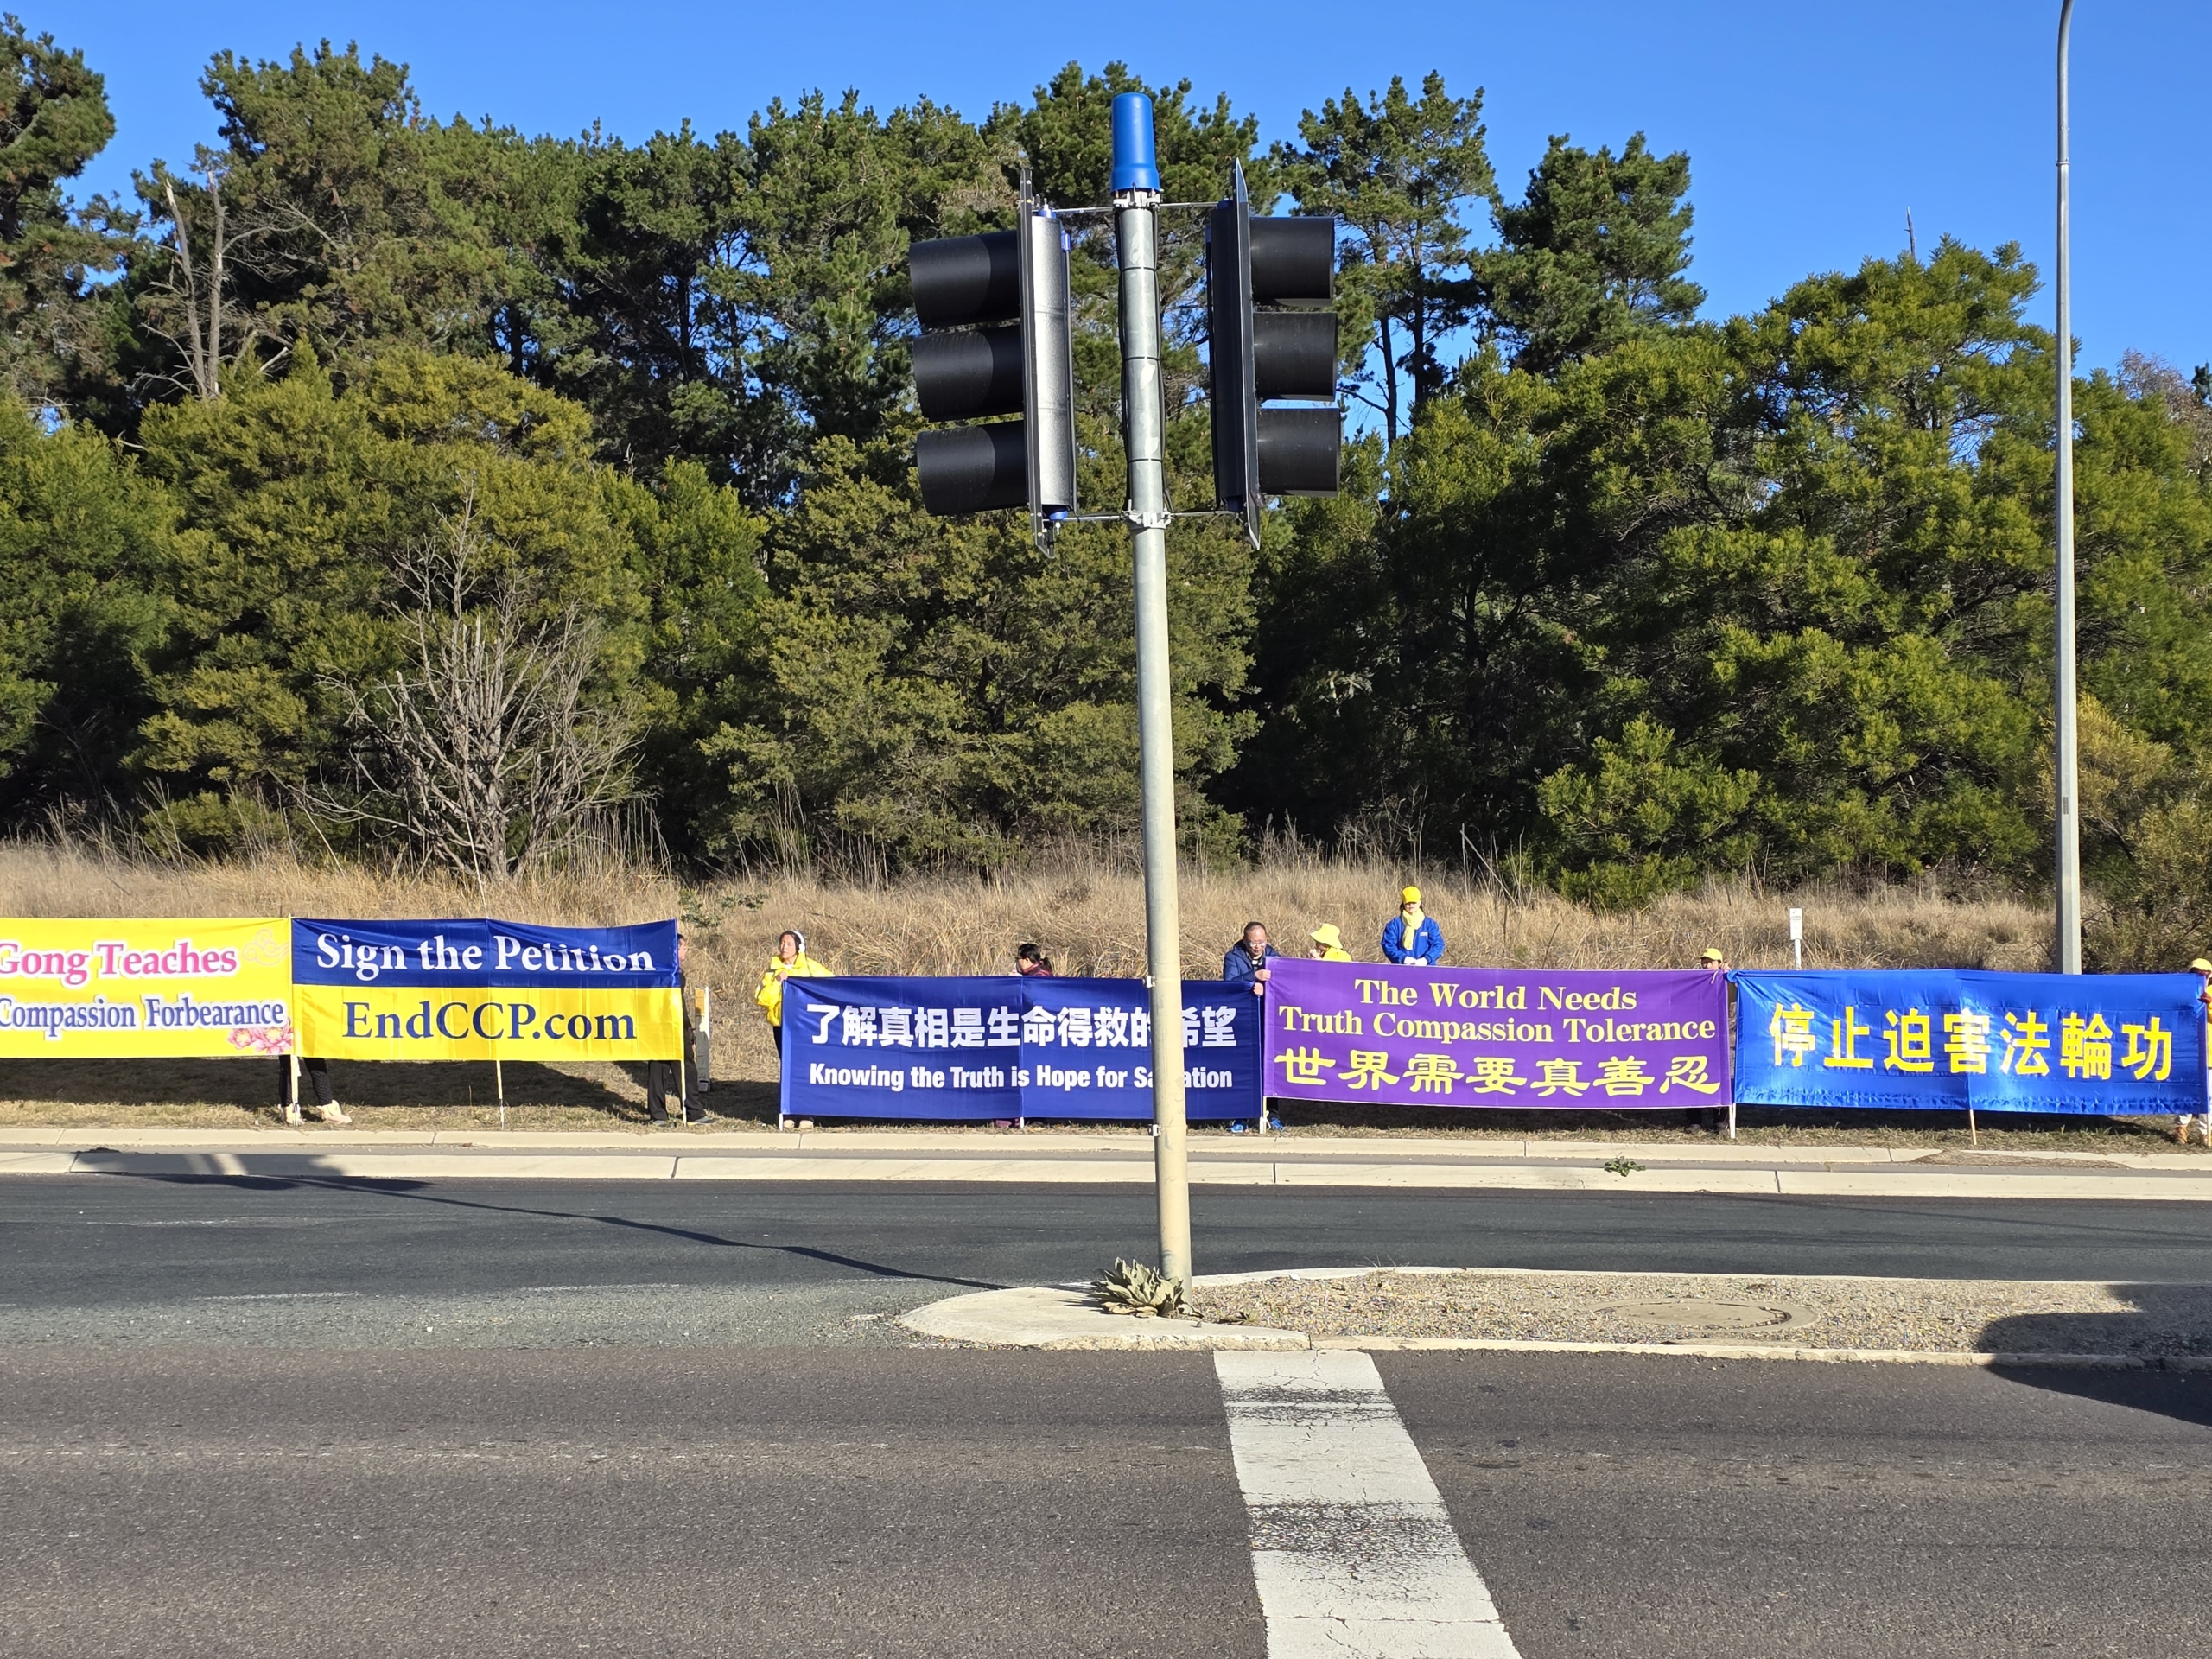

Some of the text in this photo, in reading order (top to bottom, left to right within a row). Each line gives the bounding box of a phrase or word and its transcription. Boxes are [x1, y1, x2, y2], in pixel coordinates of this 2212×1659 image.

[0, 942, 238, 985] Gong Teaches
[316, 933, 657, 982] Sign the Petition
[1354, 978, 1637, 1011] The World Needs
[0, 996, 284, 1037] Compassion Forbearance
[343, 1001, 637, 1040] EndCCP.com
[1279, 1005, 1716, 1045] Truth Compassion Tolerance
[1768, 1001, 2173, 1081] 停止迫害法輪功
[810, 1062, 1234, 1092] Knowing the Truth is Hope for Sation
[1274, 1046, 1721, 1097] 世界需要真善忍
